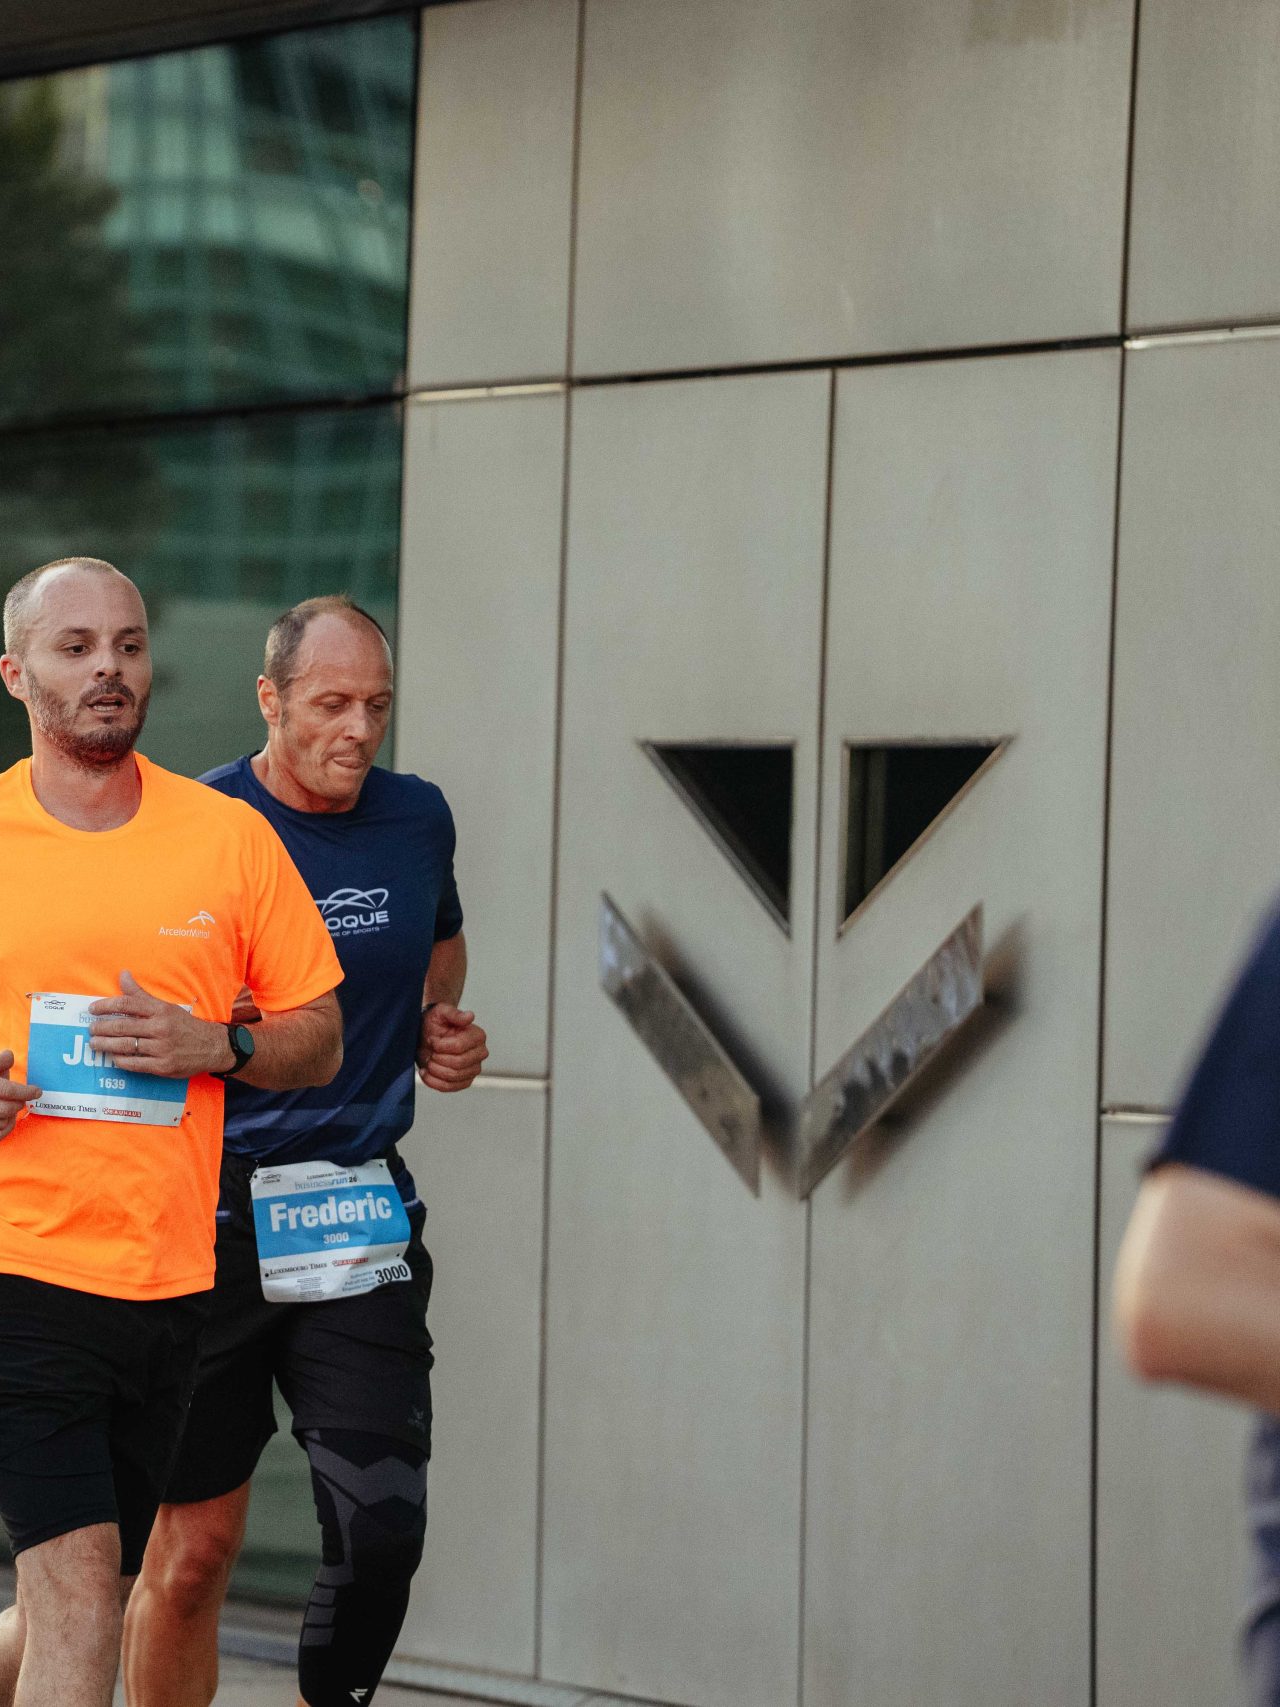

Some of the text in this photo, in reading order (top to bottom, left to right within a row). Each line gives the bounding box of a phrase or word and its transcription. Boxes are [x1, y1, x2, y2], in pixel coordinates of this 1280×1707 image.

[324, 910, 390, 931] OQUE
[99, 1077, 126, 1090] 1639
[269, 1191, 393, 1233] Frederic
[323, 1231, 350, 1244] 3000
[375, 1264, 409, 1284] 3000
